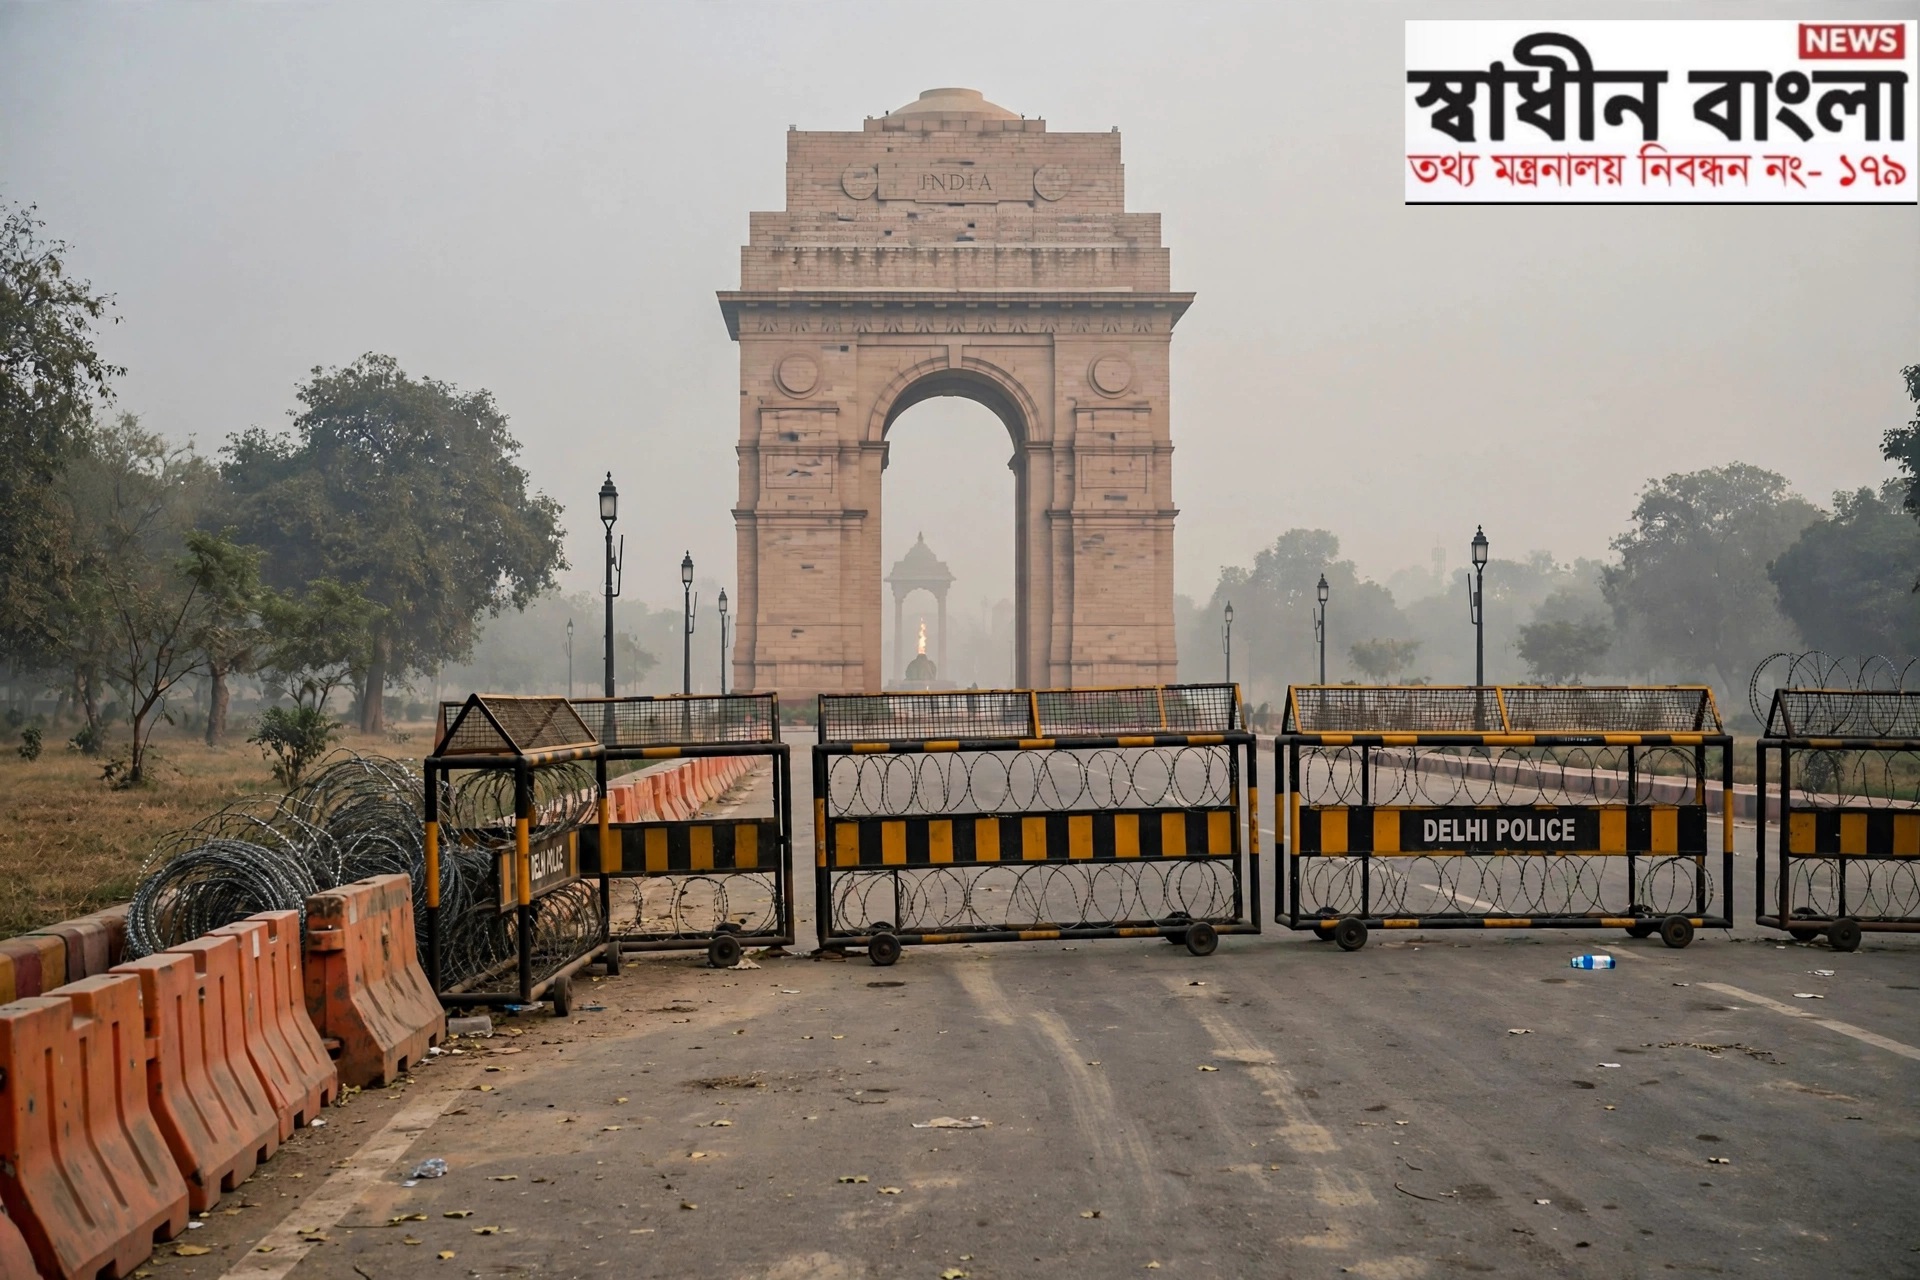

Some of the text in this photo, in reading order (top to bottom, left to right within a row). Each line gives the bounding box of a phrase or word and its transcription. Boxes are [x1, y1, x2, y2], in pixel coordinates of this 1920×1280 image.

[921, 173, 993, 191] INDIA
[1423, 818, 1575, 842] DELHI POLICE
